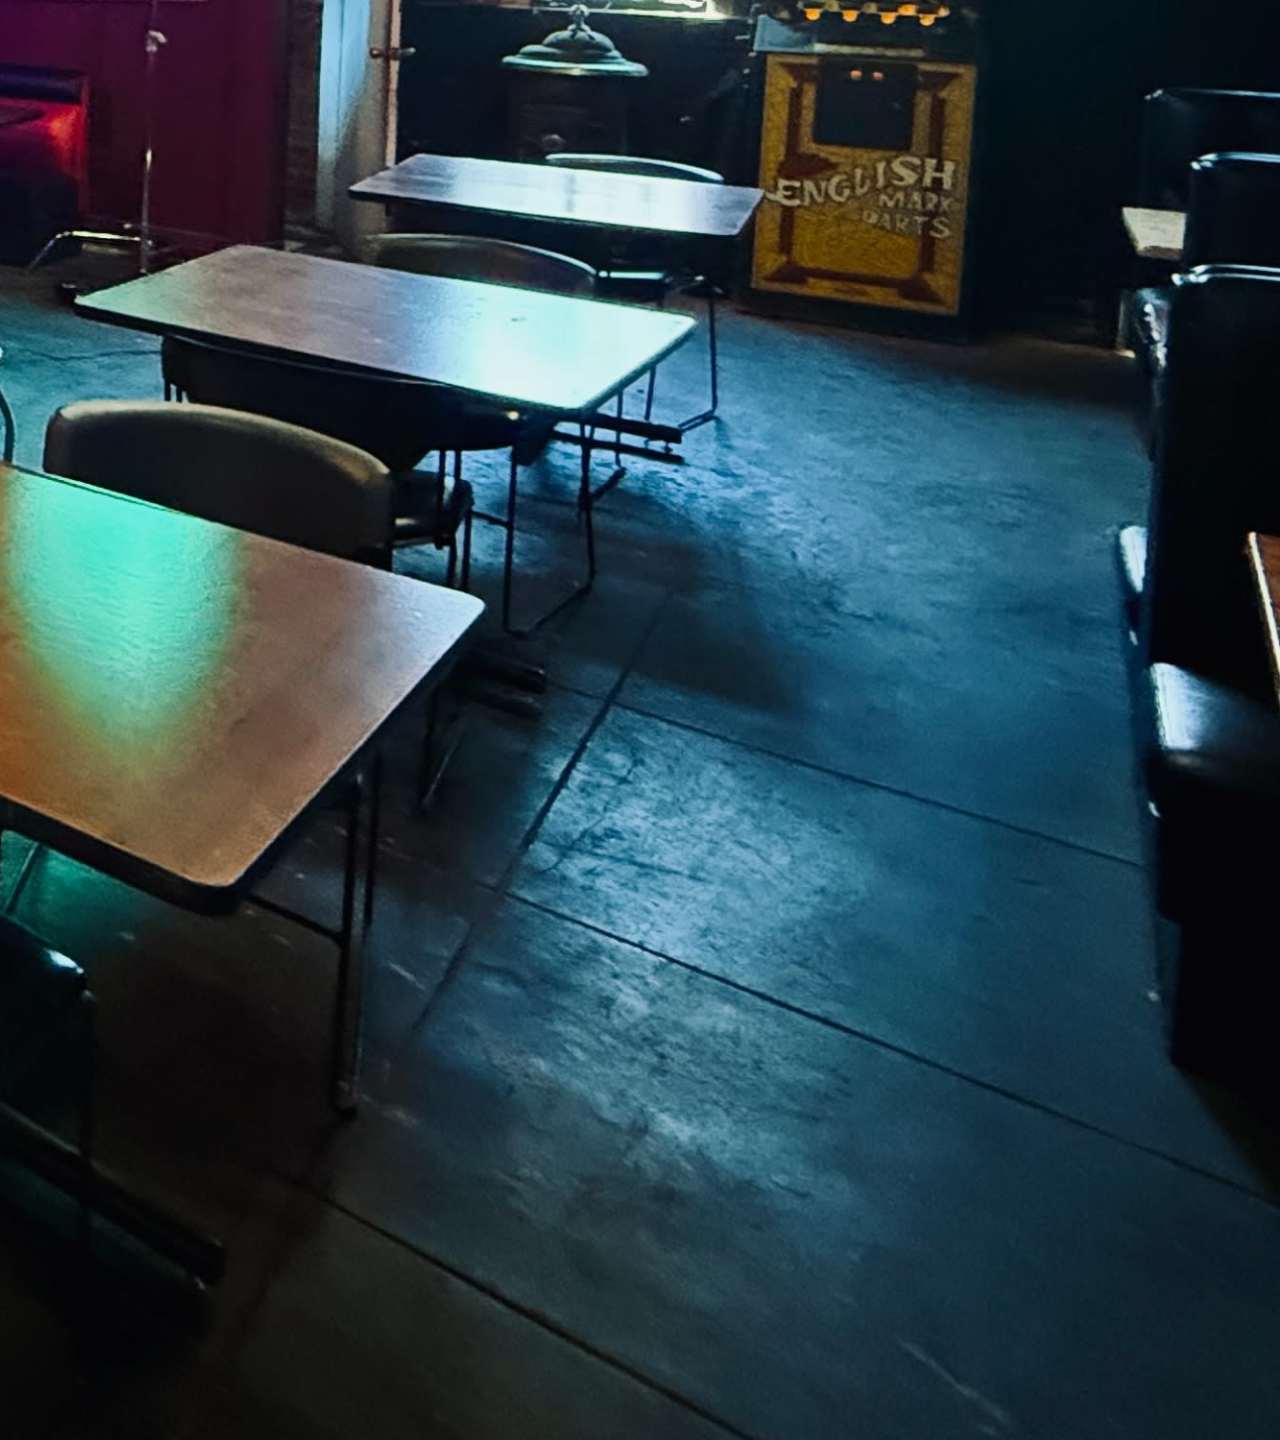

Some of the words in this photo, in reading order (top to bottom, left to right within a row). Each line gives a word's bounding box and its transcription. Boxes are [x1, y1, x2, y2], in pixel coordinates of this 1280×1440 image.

[777, 156, 956, 208] ENGLISH
[879, 191, 956, 212] MARK
[862, 210, 952, 239] DARTS
